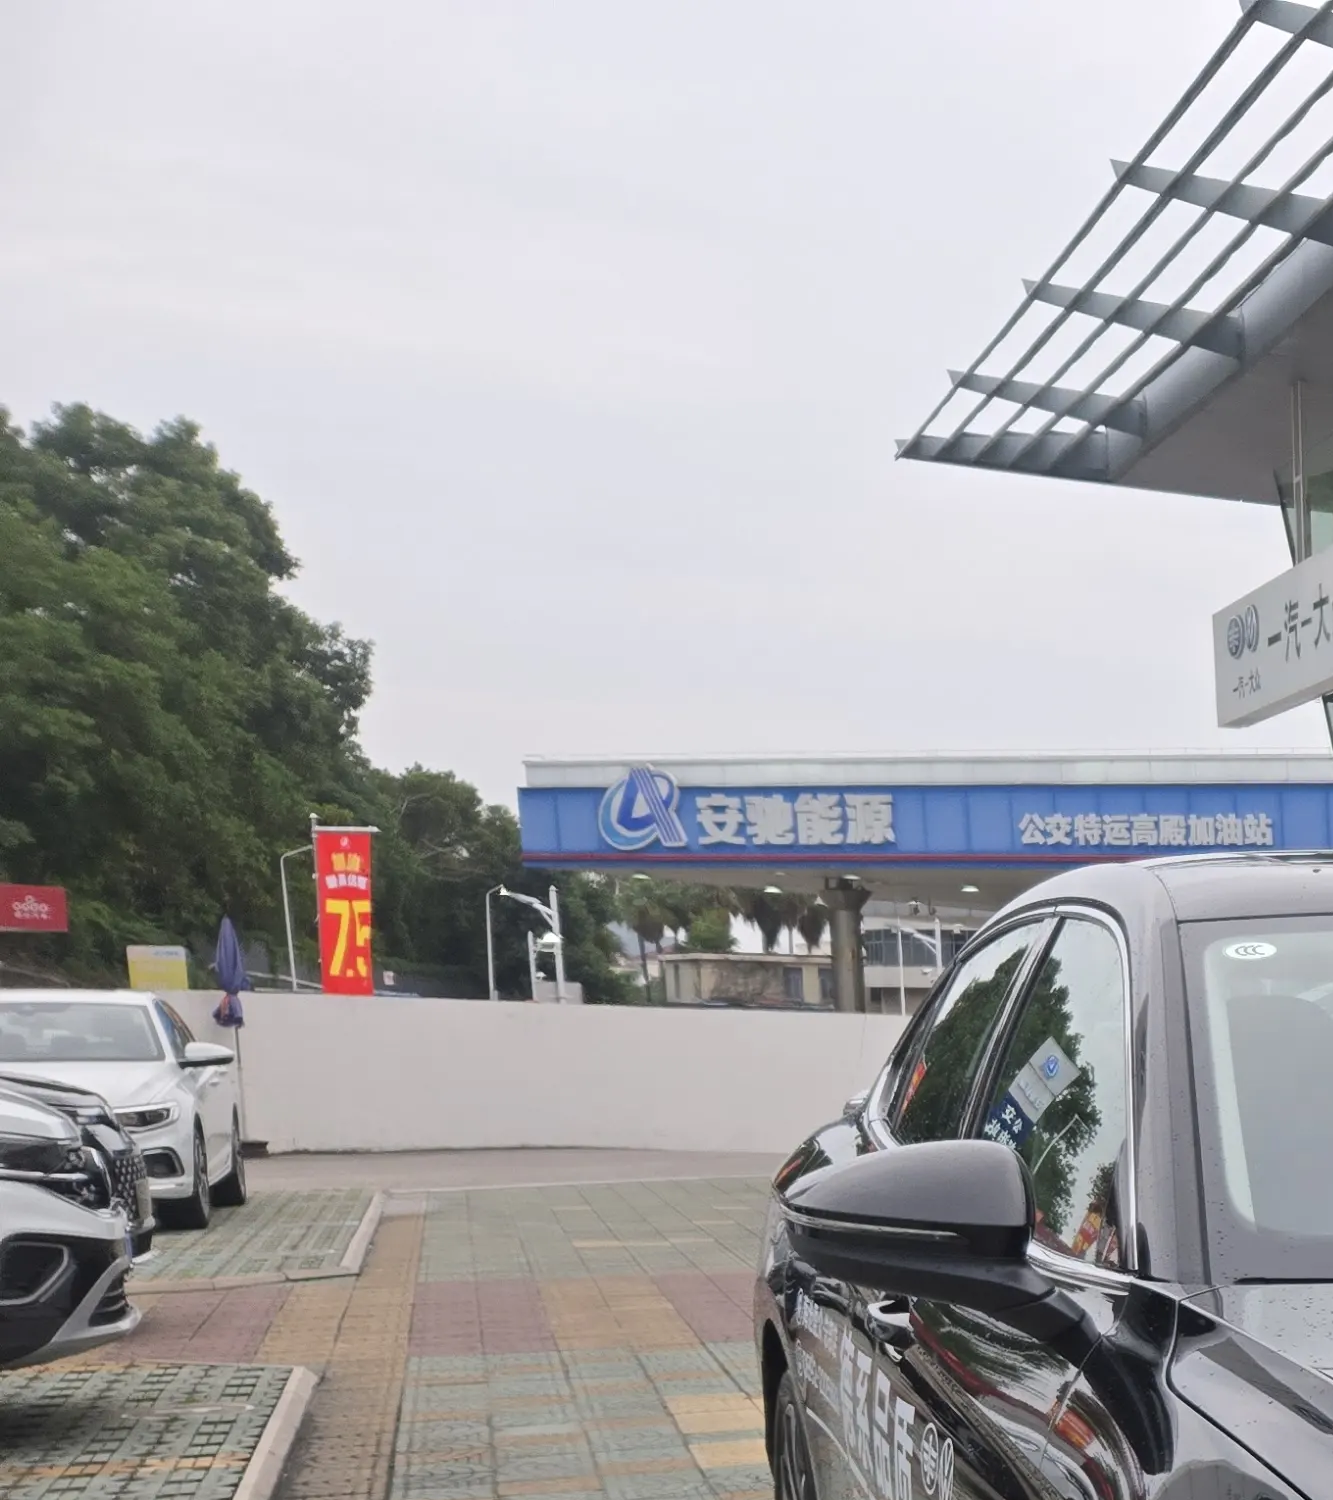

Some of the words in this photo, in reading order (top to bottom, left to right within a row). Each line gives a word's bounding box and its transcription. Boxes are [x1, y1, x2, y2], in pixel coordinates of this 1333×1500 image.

[695, 793, 896, 845] 安驰能源
[1018, 813, 1274, 846] 公交特运高殿加油站
